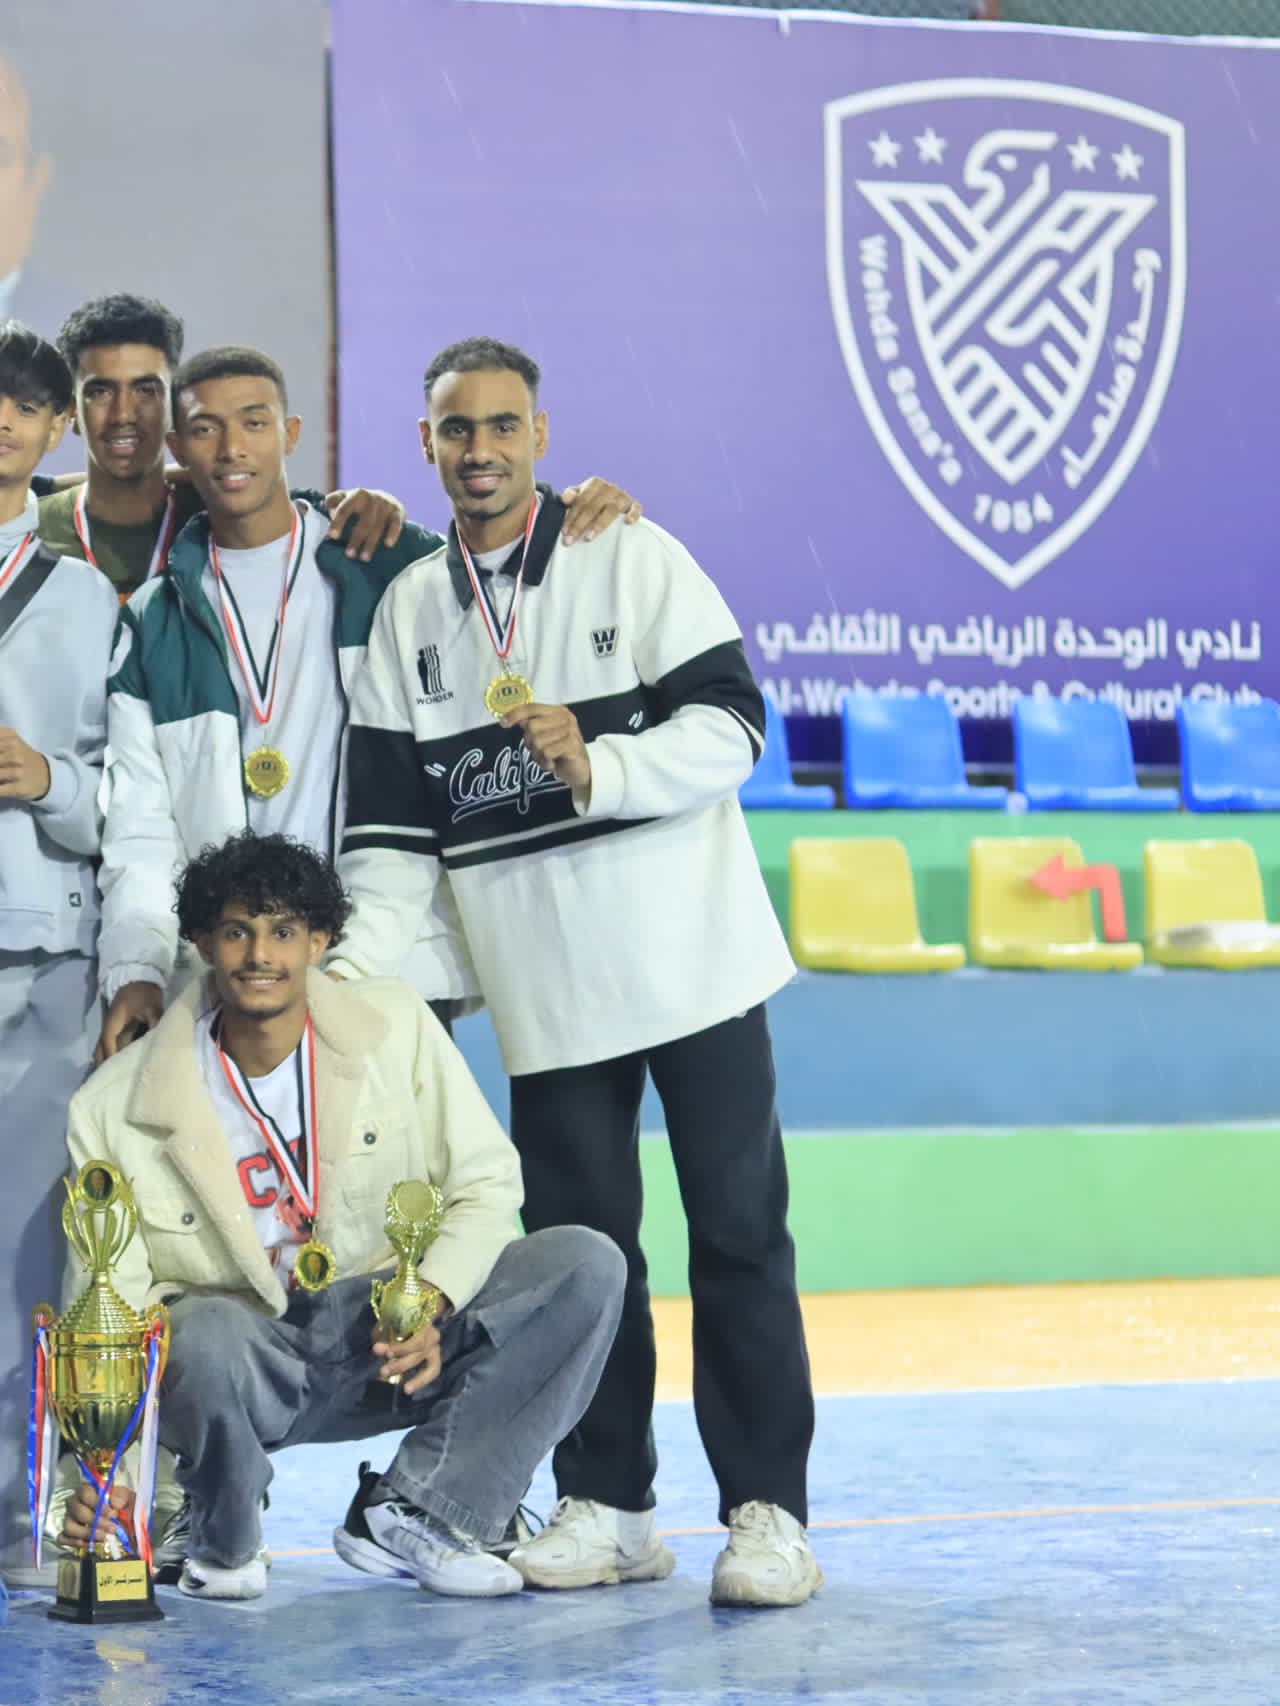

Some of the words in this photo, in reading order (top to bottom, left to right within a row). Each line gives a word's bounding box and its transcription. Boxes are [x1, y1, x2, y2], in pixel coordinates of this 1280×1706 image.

[756, 607, 901, 664] الثقافي
[909, 614, 1046, 668] الرياضي
[1053, 616, 1168, 670] الوحدة
[1175, 619, 1263, 669] نادي
[449, 738, 565, 814] Califo
